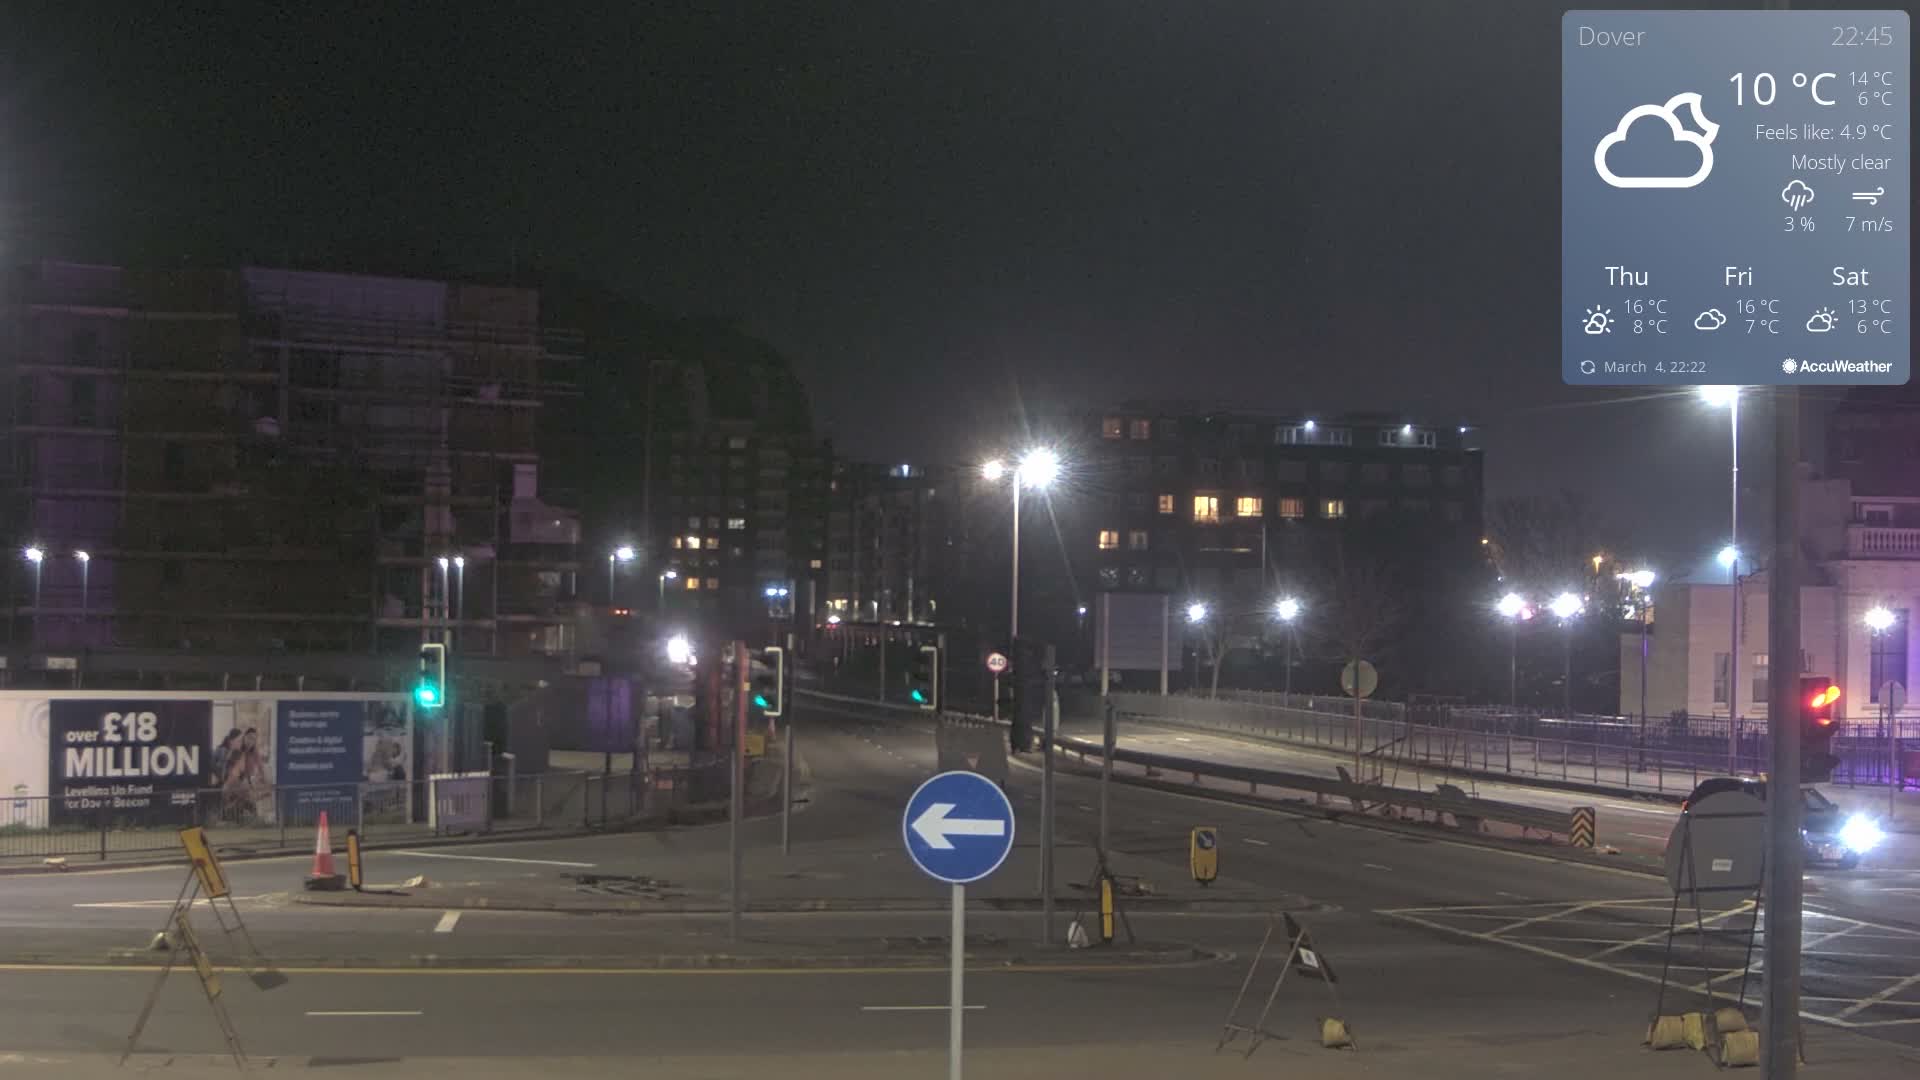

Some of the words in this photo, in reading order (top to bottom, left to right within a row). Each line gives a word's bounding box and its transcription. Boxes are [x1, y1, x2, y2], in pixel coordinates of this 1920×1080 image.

[66, 730, 99, 742] over
[103, 711, 158, 742] £18
[65, 745, 200, 778] MILLION
[128, 784, 153, 795] Fund
